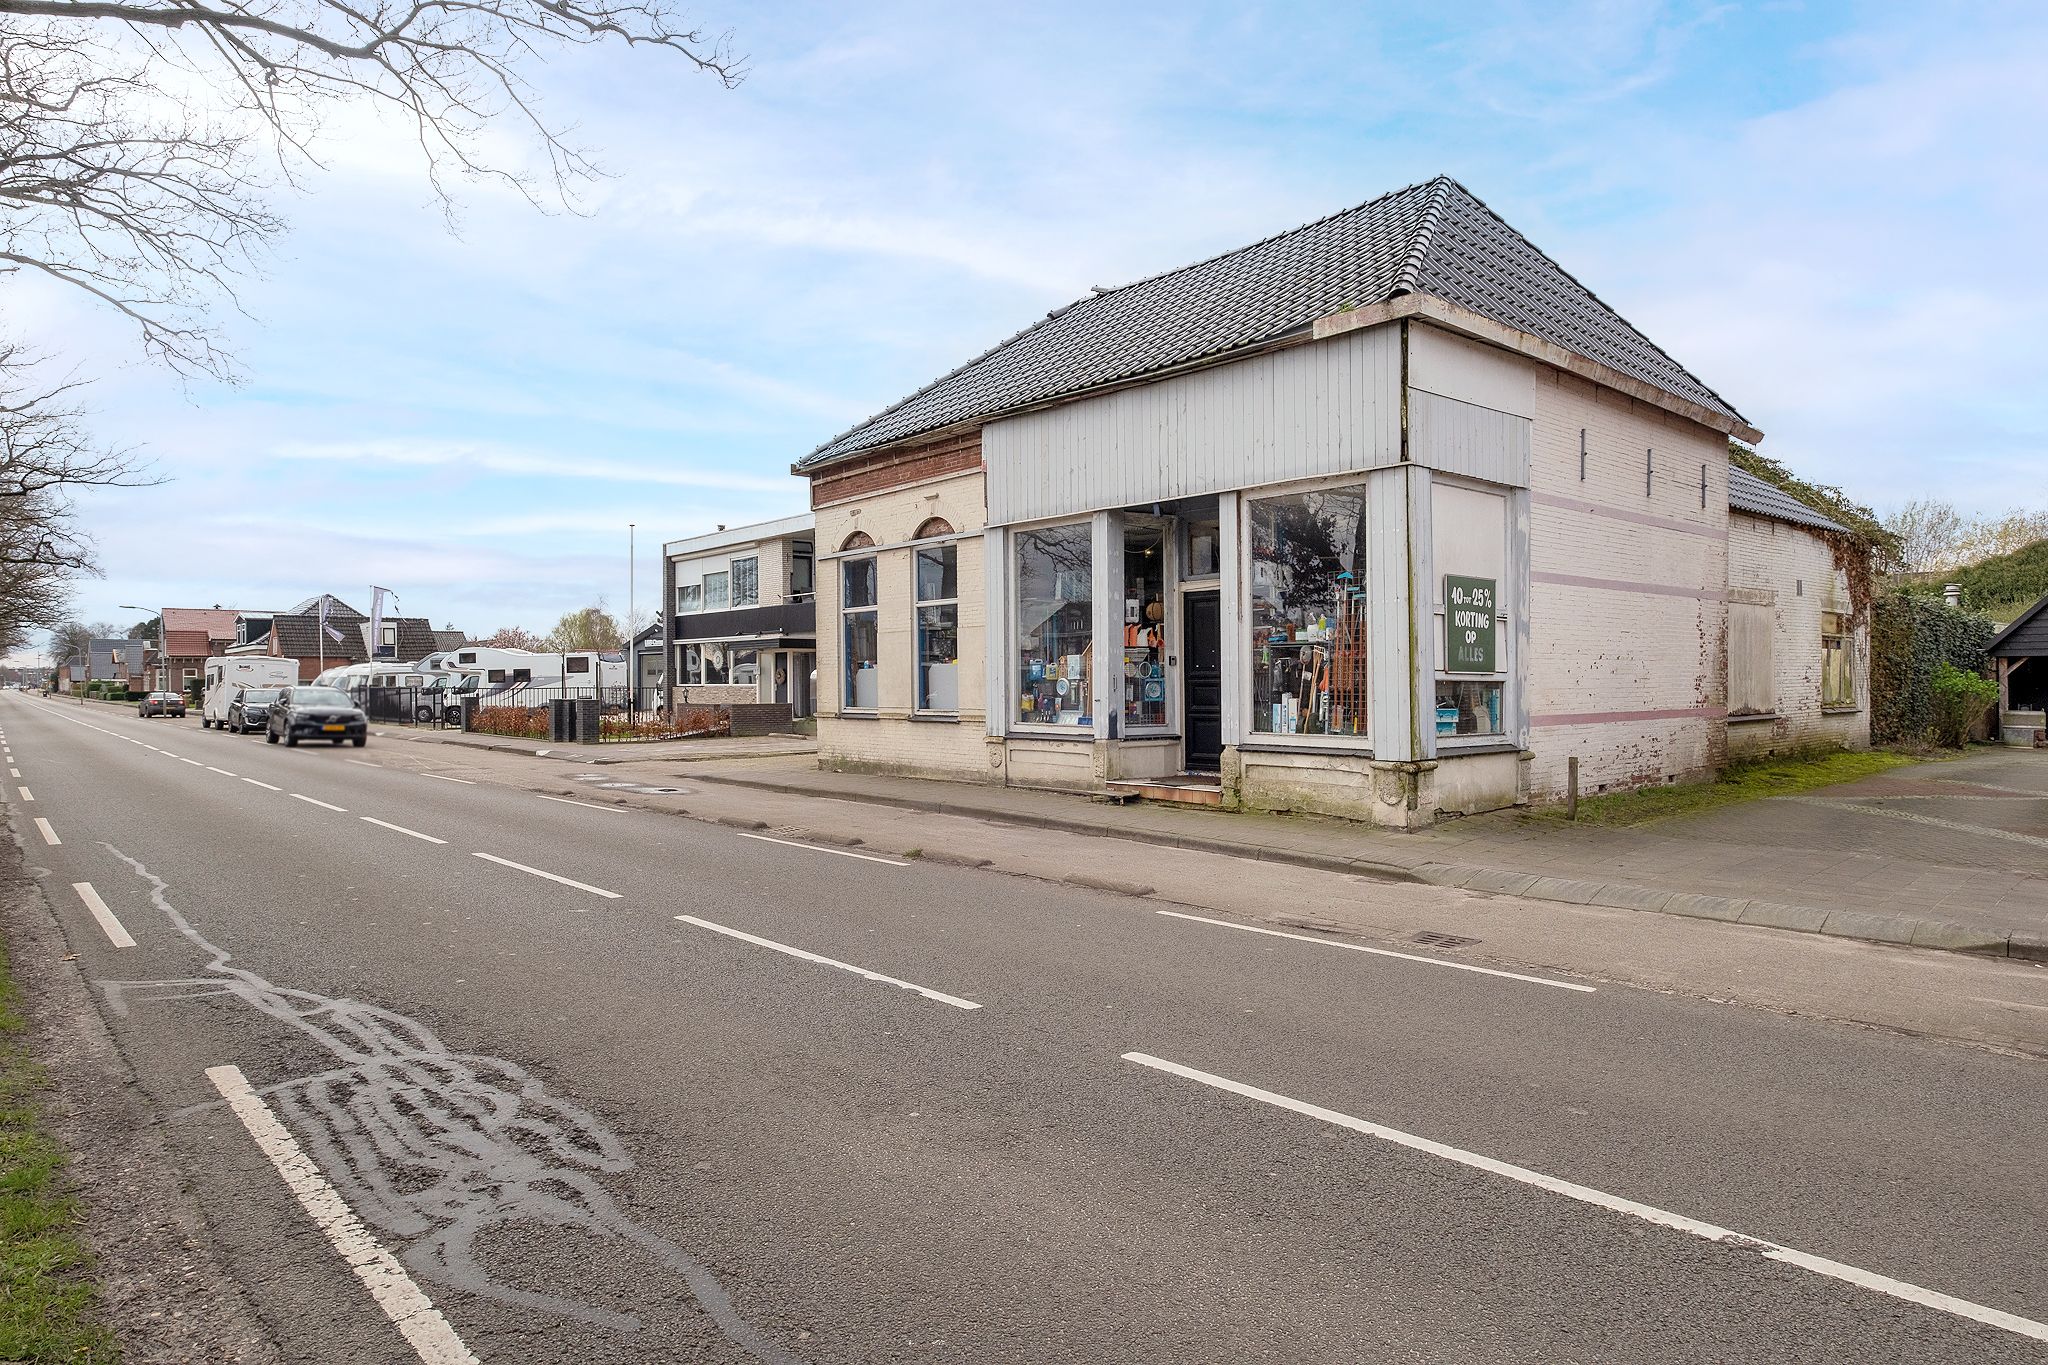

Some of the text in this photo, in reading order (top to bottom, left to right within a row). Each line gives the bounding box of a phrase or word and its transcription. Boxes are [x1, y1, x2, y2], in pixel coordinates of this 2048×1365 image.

[1451, 587, 1463, 605] 10
[1472, 588, 1492, 608] 25%
[1455, 610, 1490, 629] KORTING
[1465, 630, 1477, 644] OP
[1458, 646, 1484, 662] ALLES
